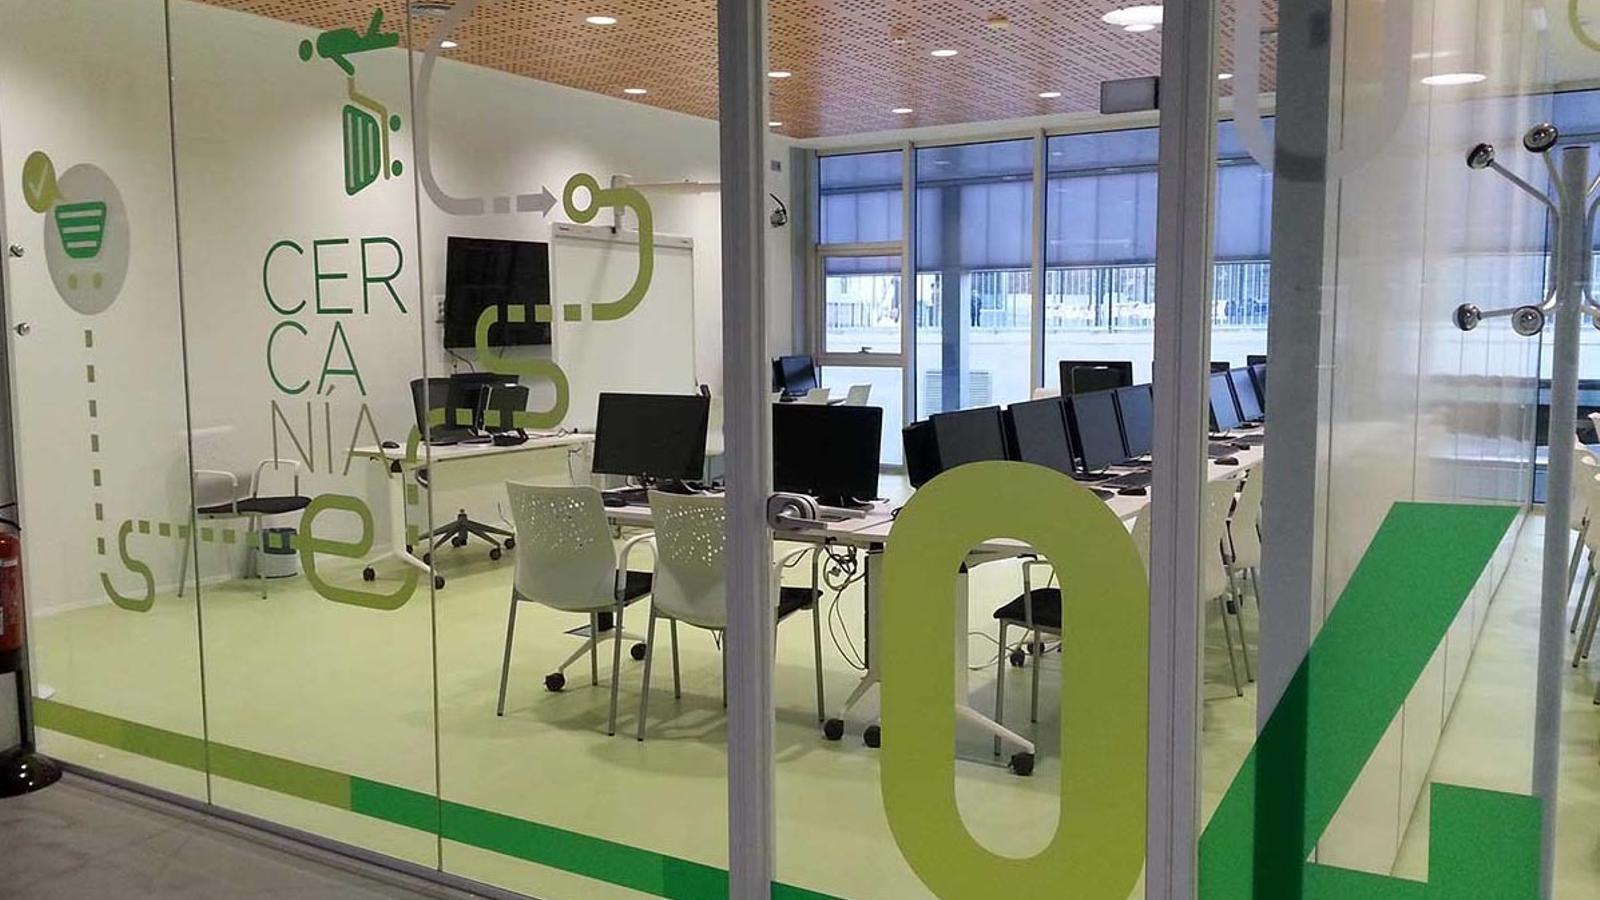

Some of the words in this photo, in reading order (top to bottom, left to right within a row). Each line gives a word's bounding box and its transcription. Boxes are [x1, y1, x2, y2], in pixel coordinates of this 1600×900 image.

[263, 237, 408, 315] CER
[267, 320, 367, 395] CA
[271, 384, 394, 479] NÍA
